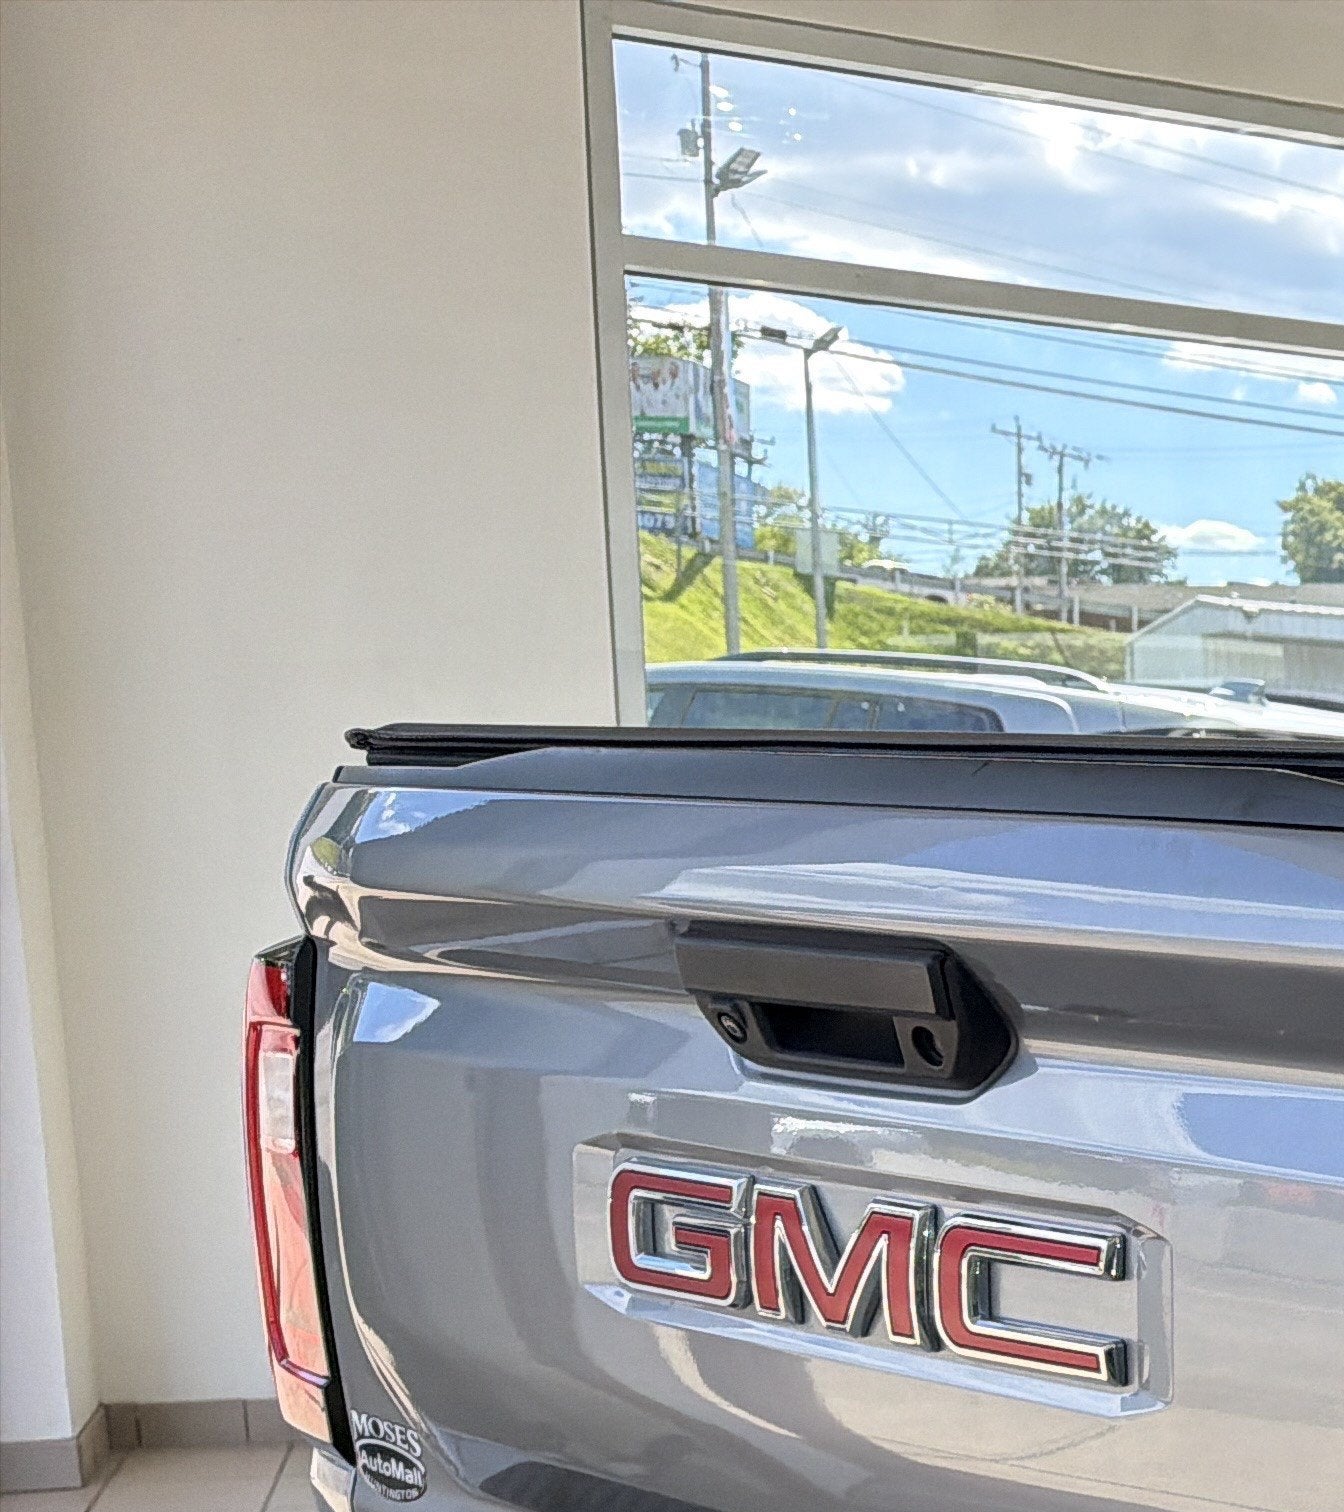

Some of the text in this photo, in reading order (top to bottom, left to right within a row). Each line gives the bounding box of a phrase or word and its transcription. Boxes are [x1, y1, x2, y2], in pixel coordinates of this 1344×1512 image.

[609, 1157, 1130, 1386] GMC
[350, 1410, 421, 1457] MOSES
[360, 1449, 424, 1488] AutoMall
